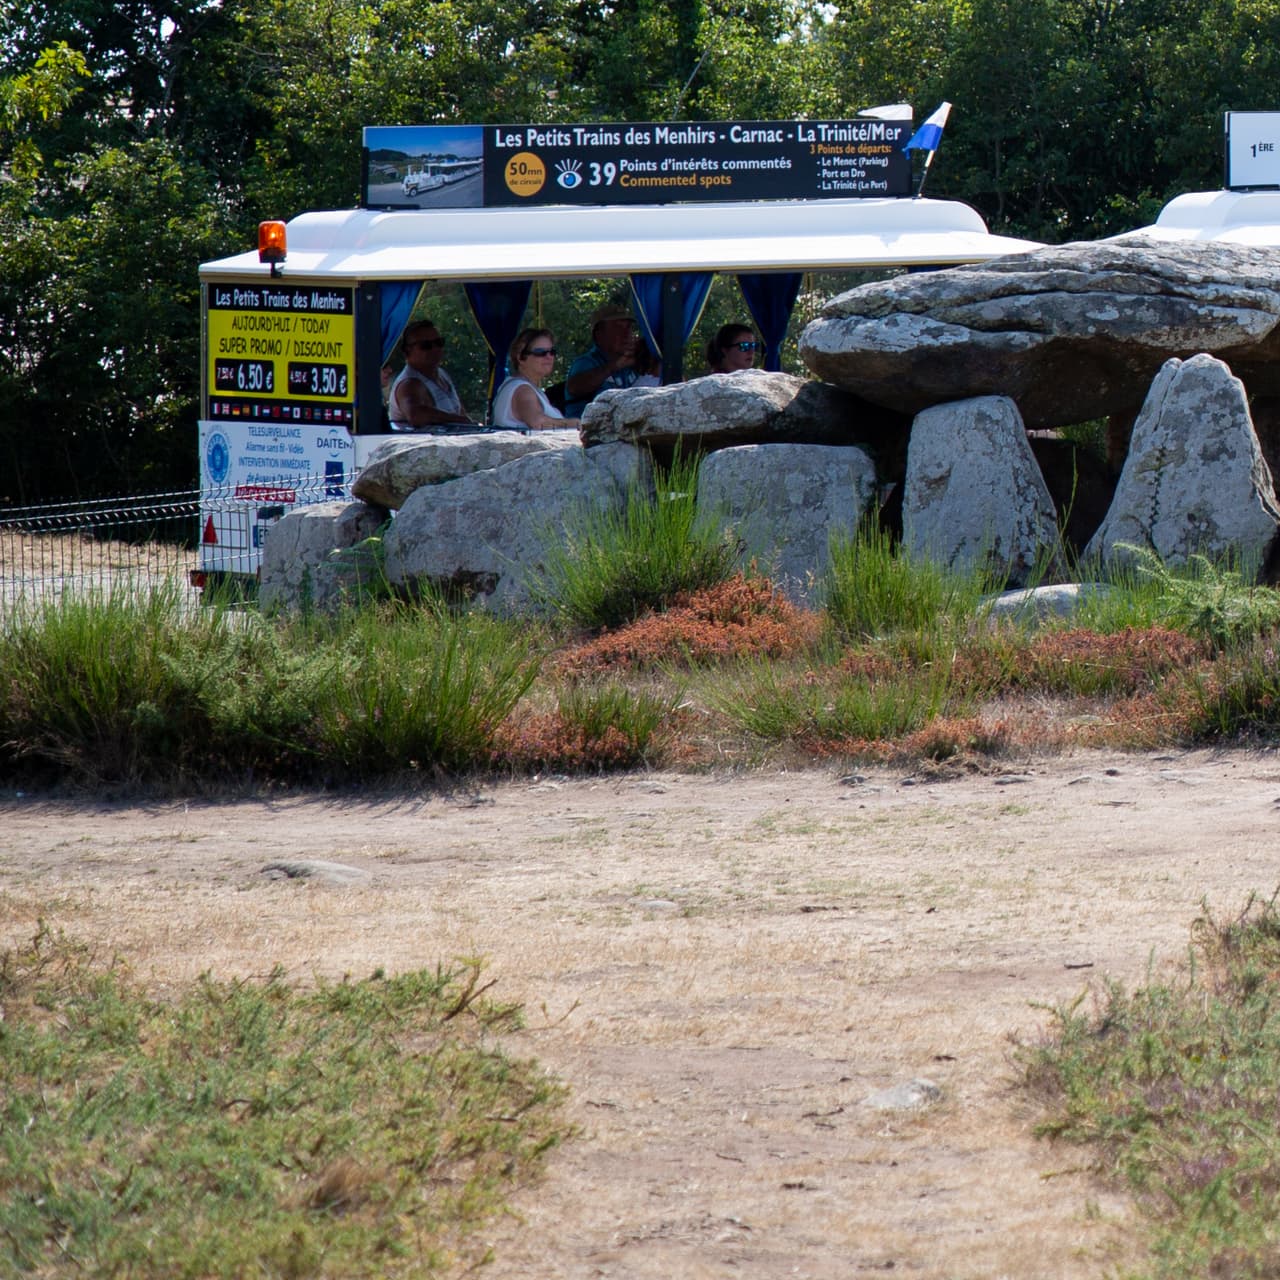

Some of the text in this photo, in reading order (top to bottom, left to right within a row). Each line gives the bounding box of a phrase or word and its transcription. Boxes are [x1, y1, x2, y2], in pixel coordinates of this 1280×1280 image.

[496, 128, 522, 147] Les
[527, 128, 571, 147] Petits
[573, 127, 621, 146] Trains
[625, 126, 650, 145] des
[655, 126, 715, 145] Menhirs
[730, 125, 783, 144] Carnac
[798, 124, 816, 142] La
[817, 123, 901, 142] Trinité/Mer
[810, 145, 815, 154] 3
[818, 144, 843, 154] Points
[845, 144, 855, 153] de
[620, 156, 792, 171] Points d'intérêts commentés
[822, 158, 832, 166] Le
[859, 156, 889, 167] (Parking)
[589, 163, 616, 186] 39
[620, 173, 732, 189] Commented spots
[822, 169, 839, 178] Port
[851, 169, 865, 177] Dro
[509, 178, 519, 186] de
[822, 181, 832, 190] La
[833, 180, 857, 190] Trinité
[871, 180, 888, 190] Port)
[215, 288, 345, 310] Les Petits Trains des Menhirs
[231, 315, 290, 333] AUJOURD'HUI
[301, 318, 330, 334] TODAY
[219, 337, 247, 354] SUPER
[250, 338, 282, 356] PROMO
[294, 340, 343, 358] DISCOUNT
[237, 363, 263, 390] 6.50
[266, 371, 273, 390] €
[311, 367, 337, 394] 3.50
[339, 375, 347, 394] €
[238, 456, 279, 469] INTERVENTION
